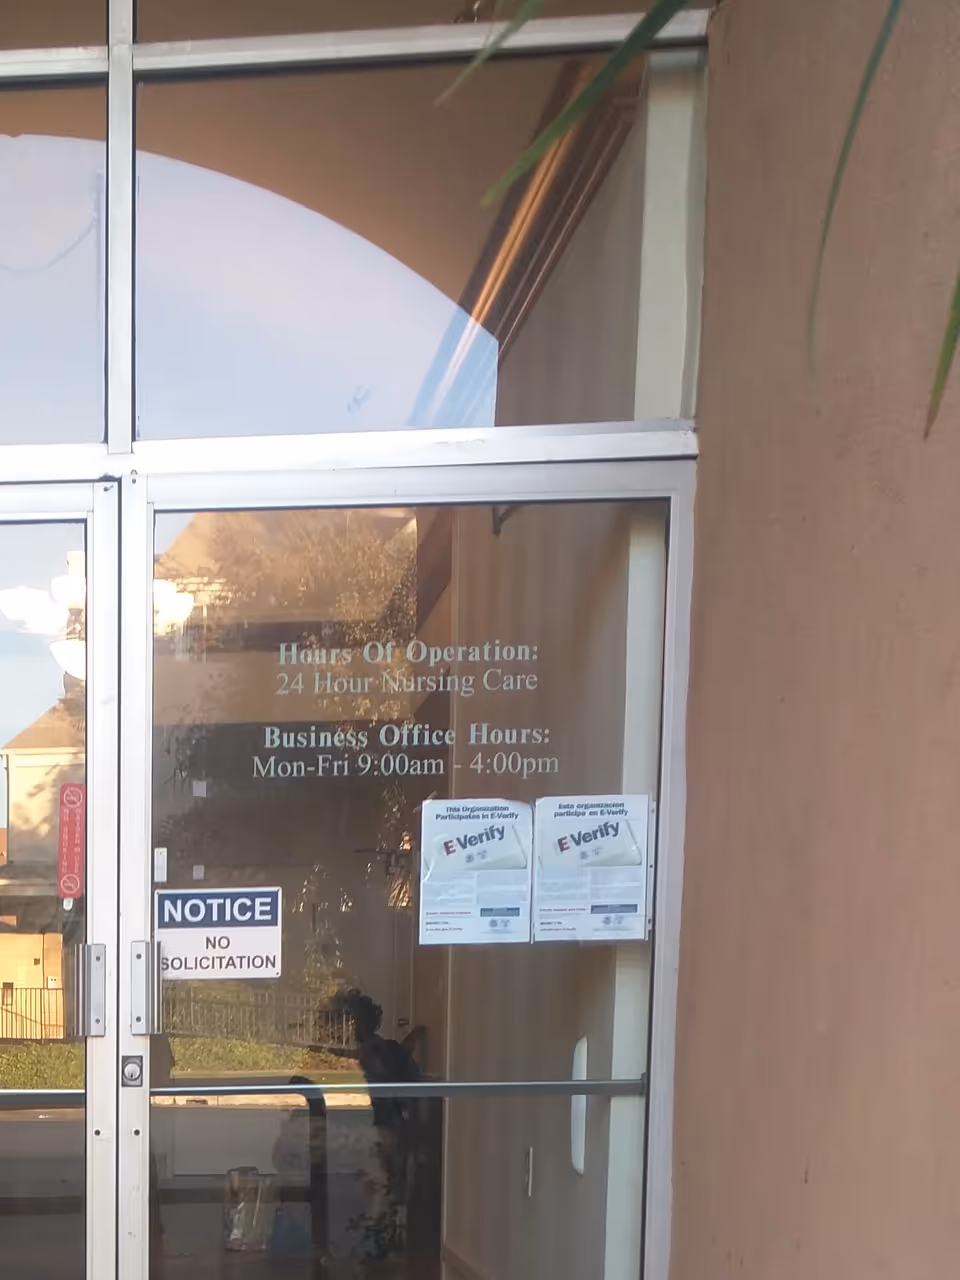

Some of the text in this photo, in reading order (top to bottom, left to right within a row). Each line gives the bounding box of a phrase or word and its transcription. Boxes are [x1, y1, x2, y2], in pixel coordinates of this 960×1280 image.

[279, 640, 538, 667] Hours Of Operation:
[275, 669, 538, 697] 24 Hour Nursing Care
[264, 722, 550, 748] Business Office Hours:
[252, 753, 349, 778] Mon-Fri
[357, 753, 445, 776] 9:00am
[469, 752, 559, 779] 4:00pm
[164, 897, 272, 922] NOTICE
[206, 936, 230, 950] NO
[161, 955, 276, 970] SOLICITATION
